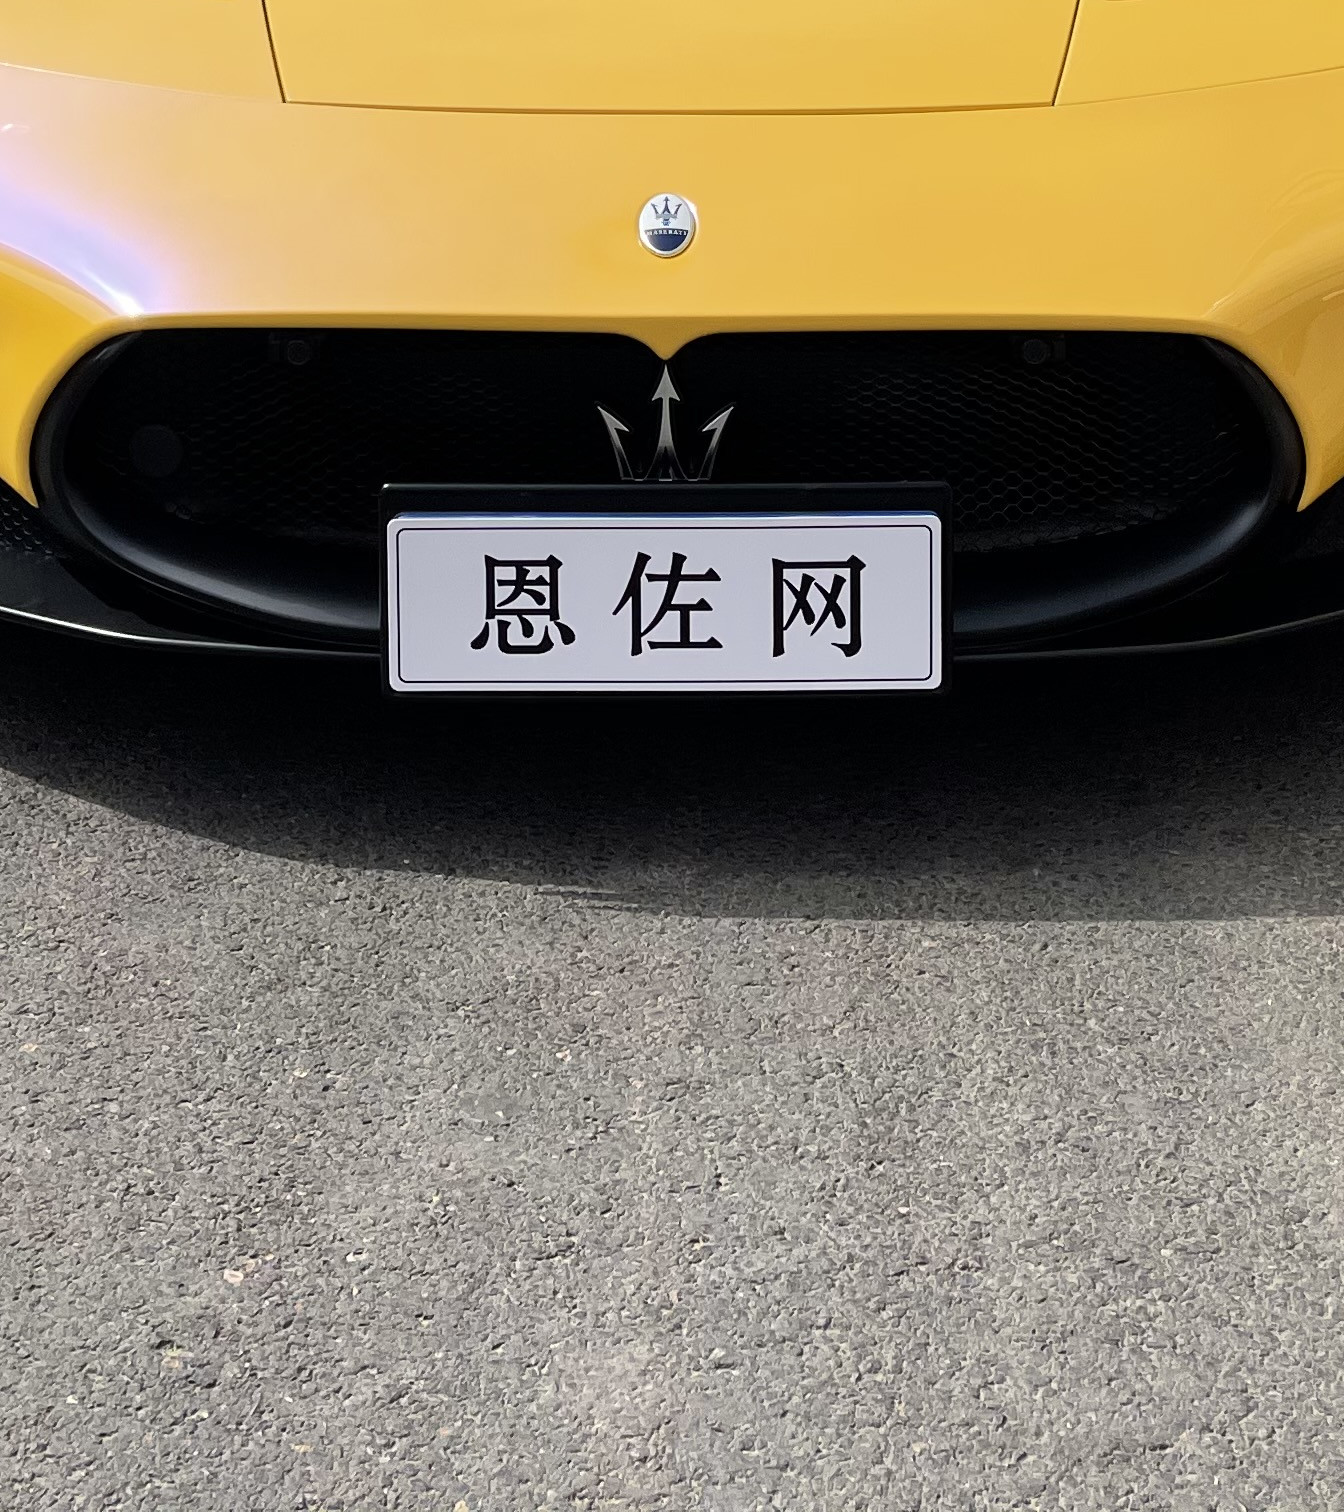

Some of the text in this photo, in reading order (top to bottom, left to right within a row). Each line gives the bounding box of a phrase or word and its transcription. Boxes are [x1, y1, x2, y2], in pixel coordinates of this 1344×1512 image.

[645, 228, 687, 237] MASERATI
[469, 550, 868, 659] 恩佐网
